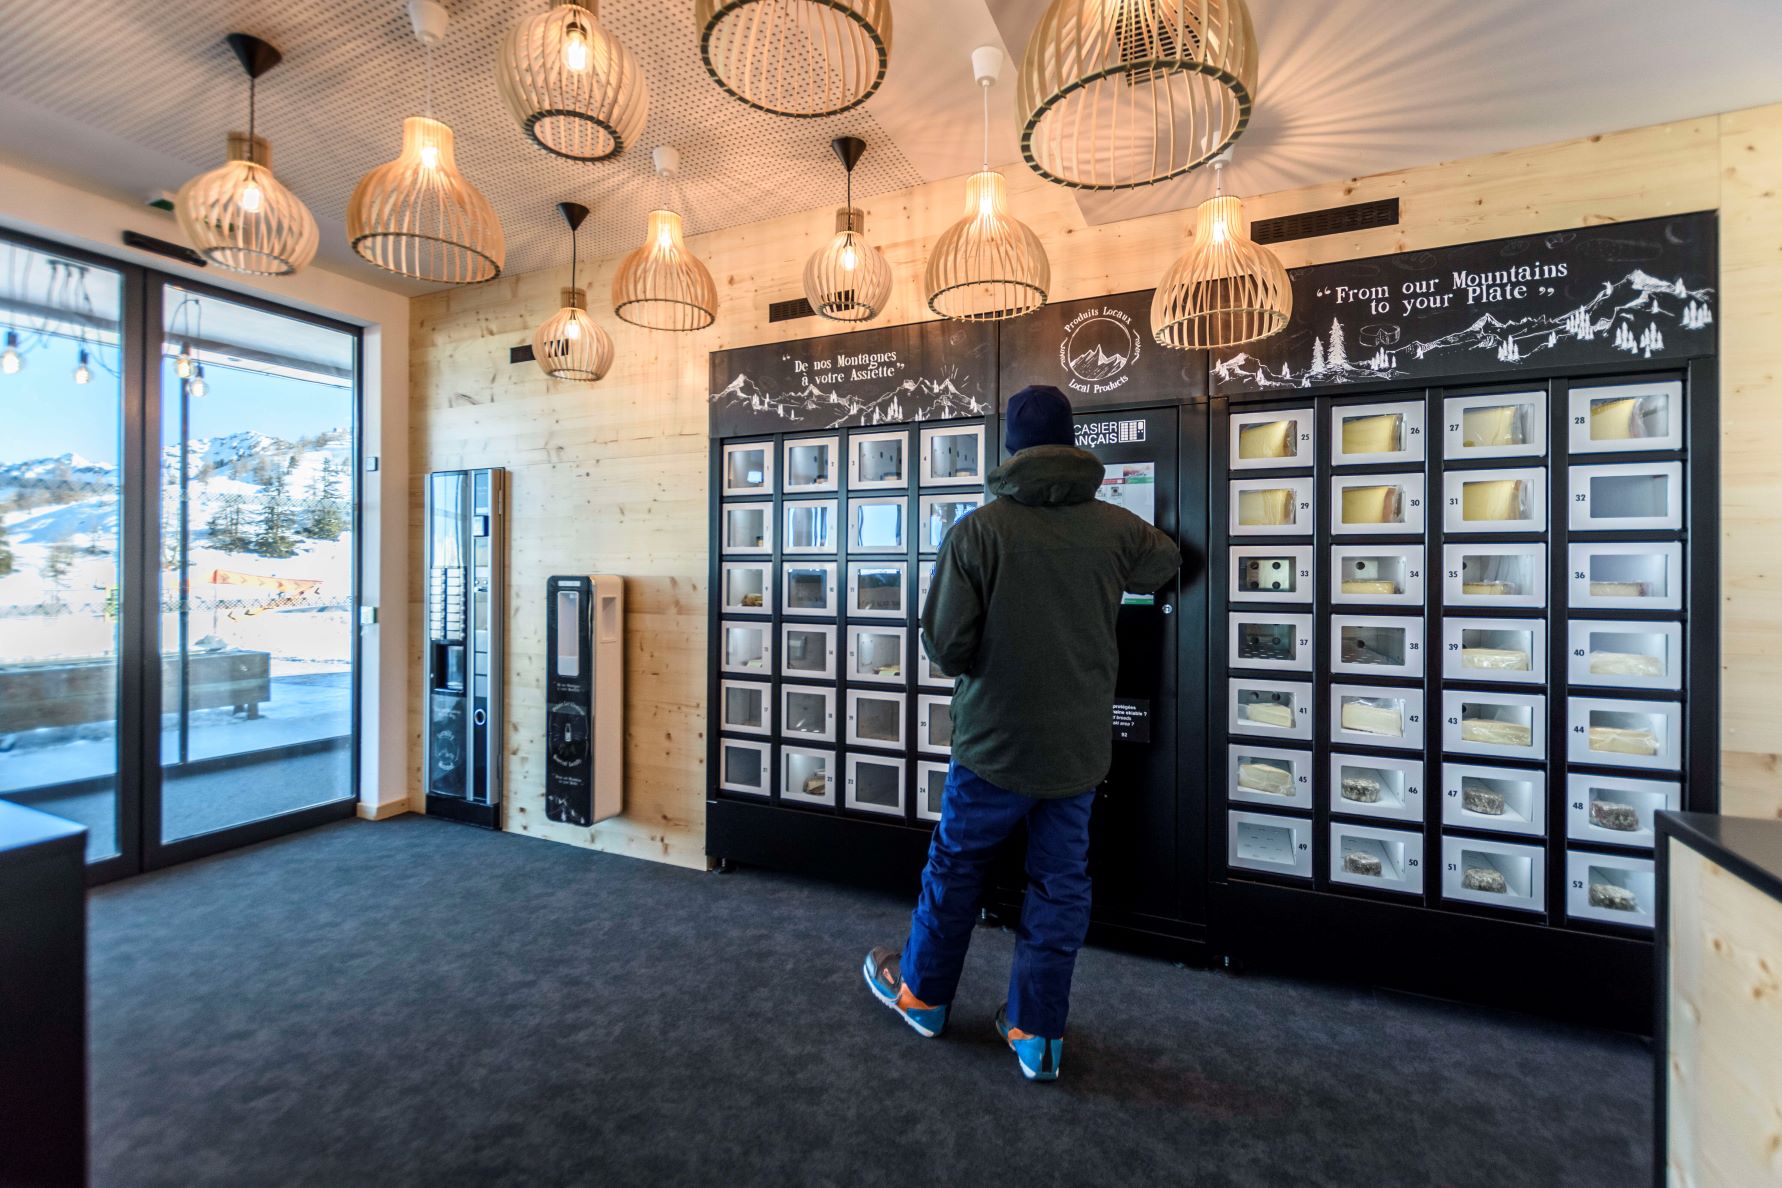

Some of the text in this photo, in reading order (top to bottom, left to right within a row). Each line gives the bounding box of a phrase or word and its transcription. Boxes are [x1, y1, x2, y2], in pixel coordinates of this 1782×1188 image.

[1402, 278, 1439, 295] our
[1452, 262, 1568, 290] Mountains
[1370, 299, 1390, 315] to
[1402, 292, 1453, 317] your
[1466, 283, 1527, 304] Plate
[1064, 306, 1132, 333] Produits Locaux
[794, 360, 809, 373] De
[814, 360, 832, 370] nos
[837, 351, 897, 370] Montagnes
[801, 373, 809, 386] à
[815, 372, 845, 385] votre
[1068, 374, 1129, 394] Local Products
[1574, 416, 1586, 425] 28
[1074, 421, 1118, 436] CASIER
[1410, 426, 1421, 435] 26
[1449, 423, 1460, 432] 27
[1301, 433, 1310, 441] 25
[1449, 497, 1459, 506] 31
[1575, 493, 1586, 502] 32
[1300, 502, 1310, 510] 29
[1410, 499, 1421, 507] 30
[1300, 569, 1310, 577] 33
[1409, 570, 1420, 578] 34
[1448, 570, 1458, 578] 35
[1574, 571, 1586, 580] 36
[1299, 638, 1309, 646] 37
[1409, 642, 1419, 650] 38
[1448, 643, 1459, 651] 39
[1573, 648, 1585, 657] 40
[1298, 707, 1308, 715] 41
[1409, 714, 1419, 723] 42
[1447, 717, 1458, 725] 43
[1573, 725, 1585, 734] 44
[1298, 775, 1308, 784] 45
[1408, 786, 1418, 795] 46
[1447, 789, 1458, 798] 47
[1572, 801, 1584, 810] 48
[1298, 843, 1308, 851] 49
[1408, 858, 1419, 867] 50
[1447, 863, 1457, 872] 51
[1572, 880, 1584, 889] 52
